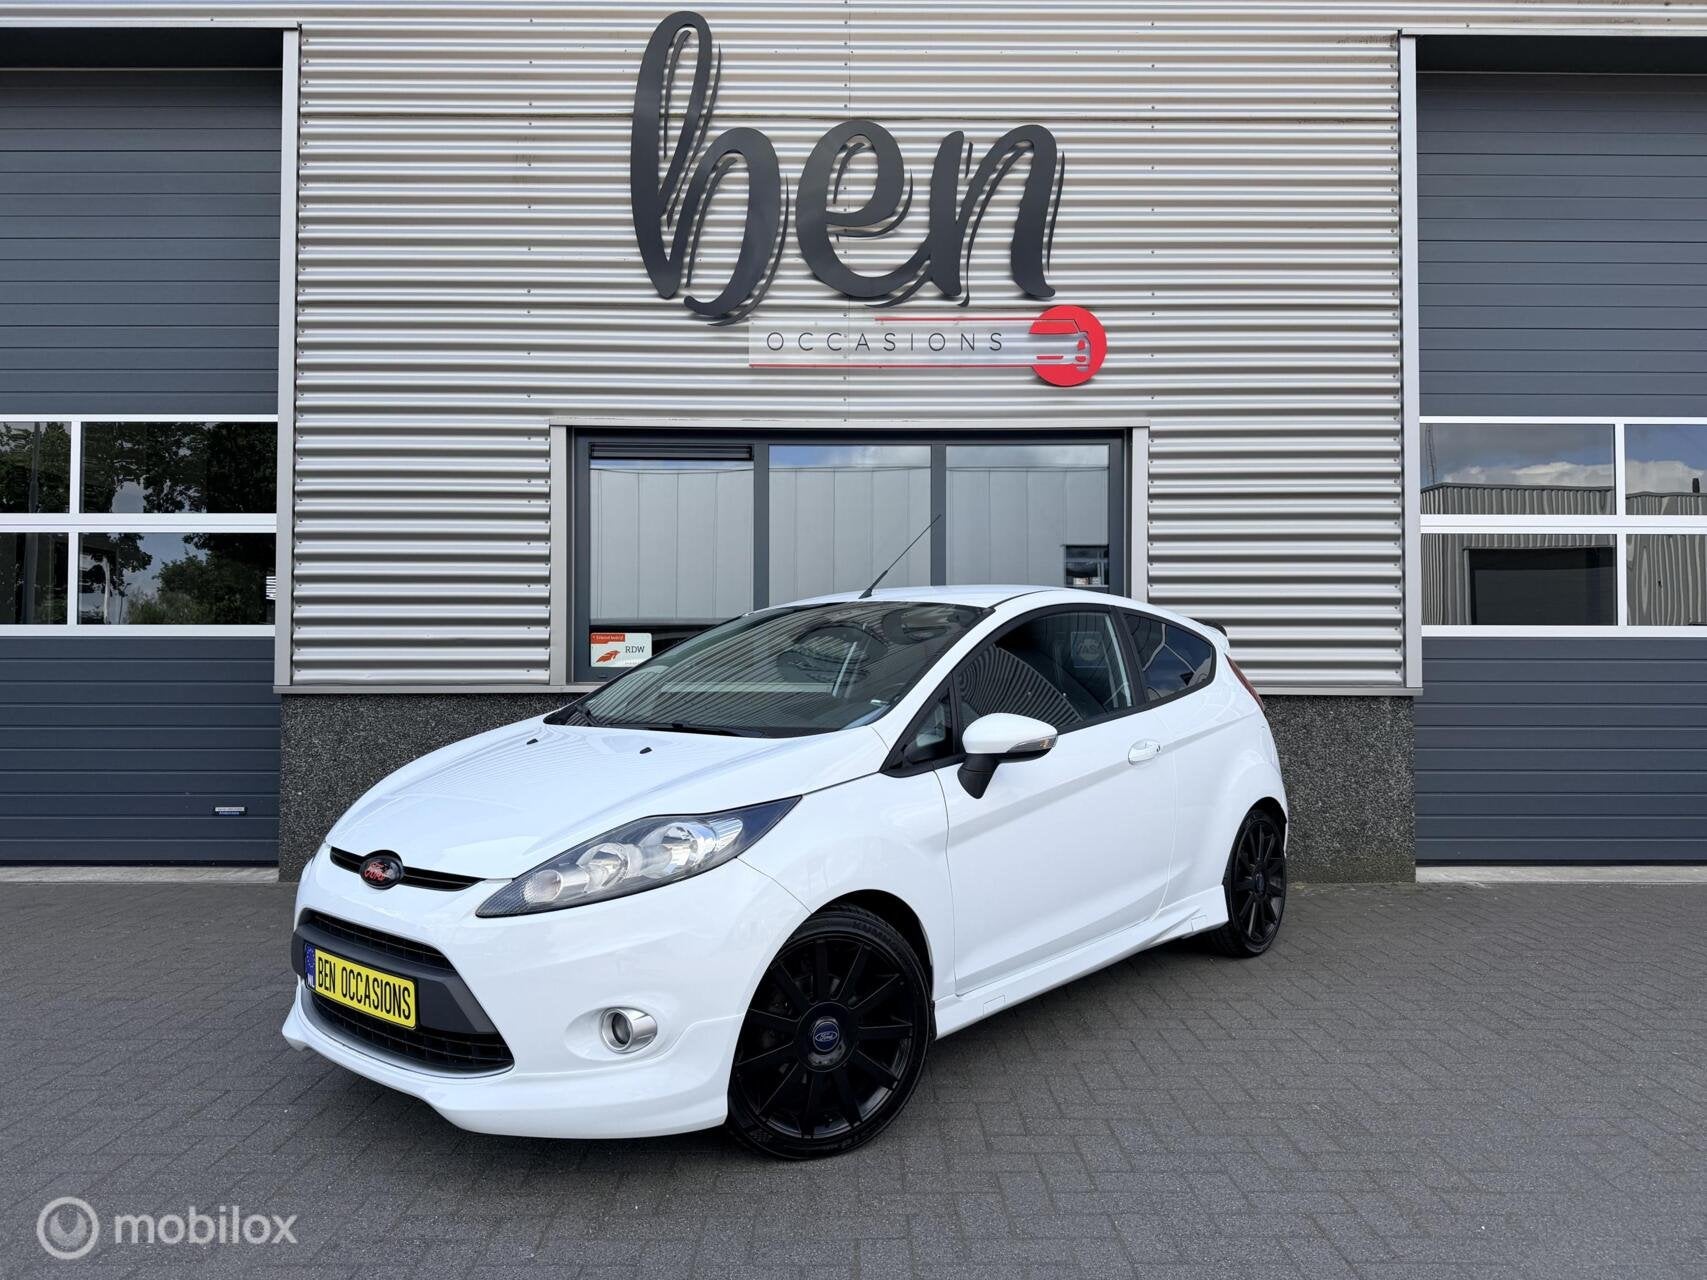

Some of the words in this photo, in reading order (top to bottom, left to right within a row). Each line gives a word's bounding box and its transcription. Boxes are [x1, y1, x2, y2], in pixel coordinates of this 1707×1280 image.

[630, 11, 1064, 325] ben
[766, 331, 1004, 353] OCCASIONS
[625, 645, 645, 654] RDW
[318, 957, 336, 994] BEN
[341, 966, 411, 1021] OCCASIONS
